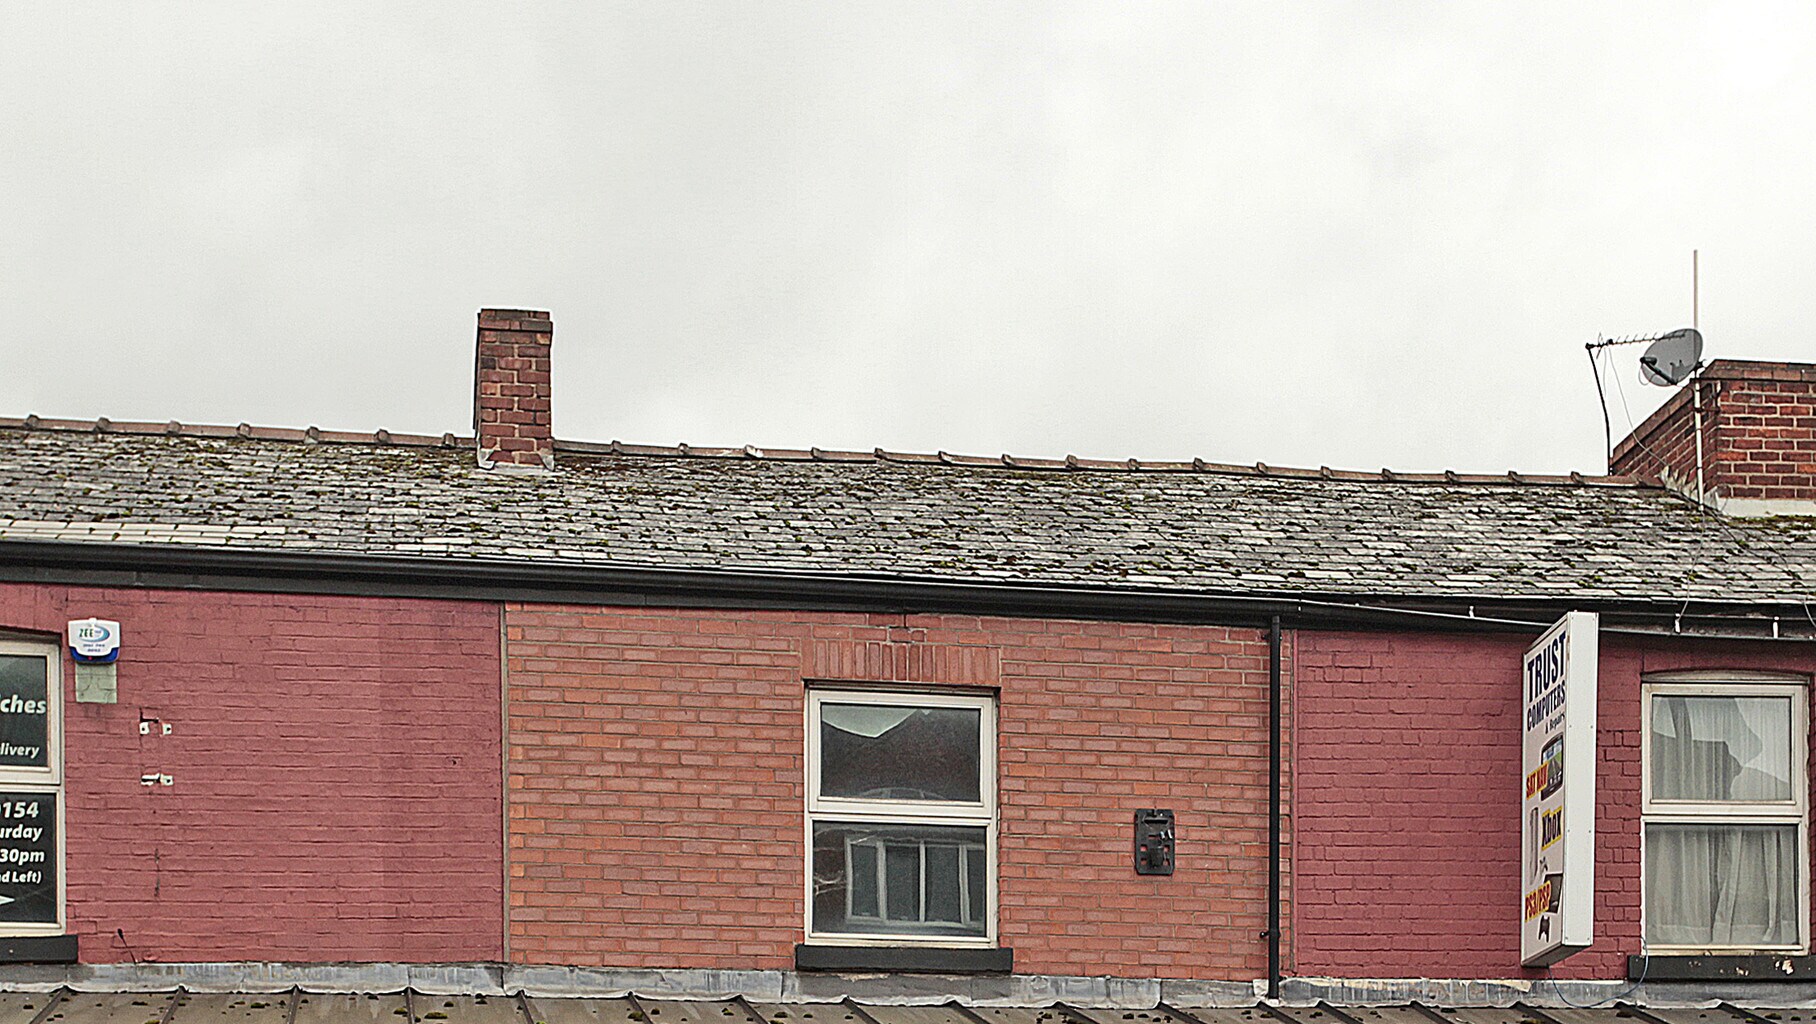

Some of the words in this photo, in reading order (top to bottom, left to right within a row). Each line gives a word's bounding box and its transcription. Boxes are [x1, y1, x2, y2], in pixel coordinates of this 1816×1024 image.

[1528, 631, 1566, 703] TRUST
[0, 694, 46, 714] ches
[1527, 680, 1566, 732] COMPUTERS
[0, 742, 40, 759] livery
[0, 802, 39, 819] 154
[0, 848, 45, 866] 30pm
[0, 870, 10, 883] d
[12, 870, 42, 884] Left)
